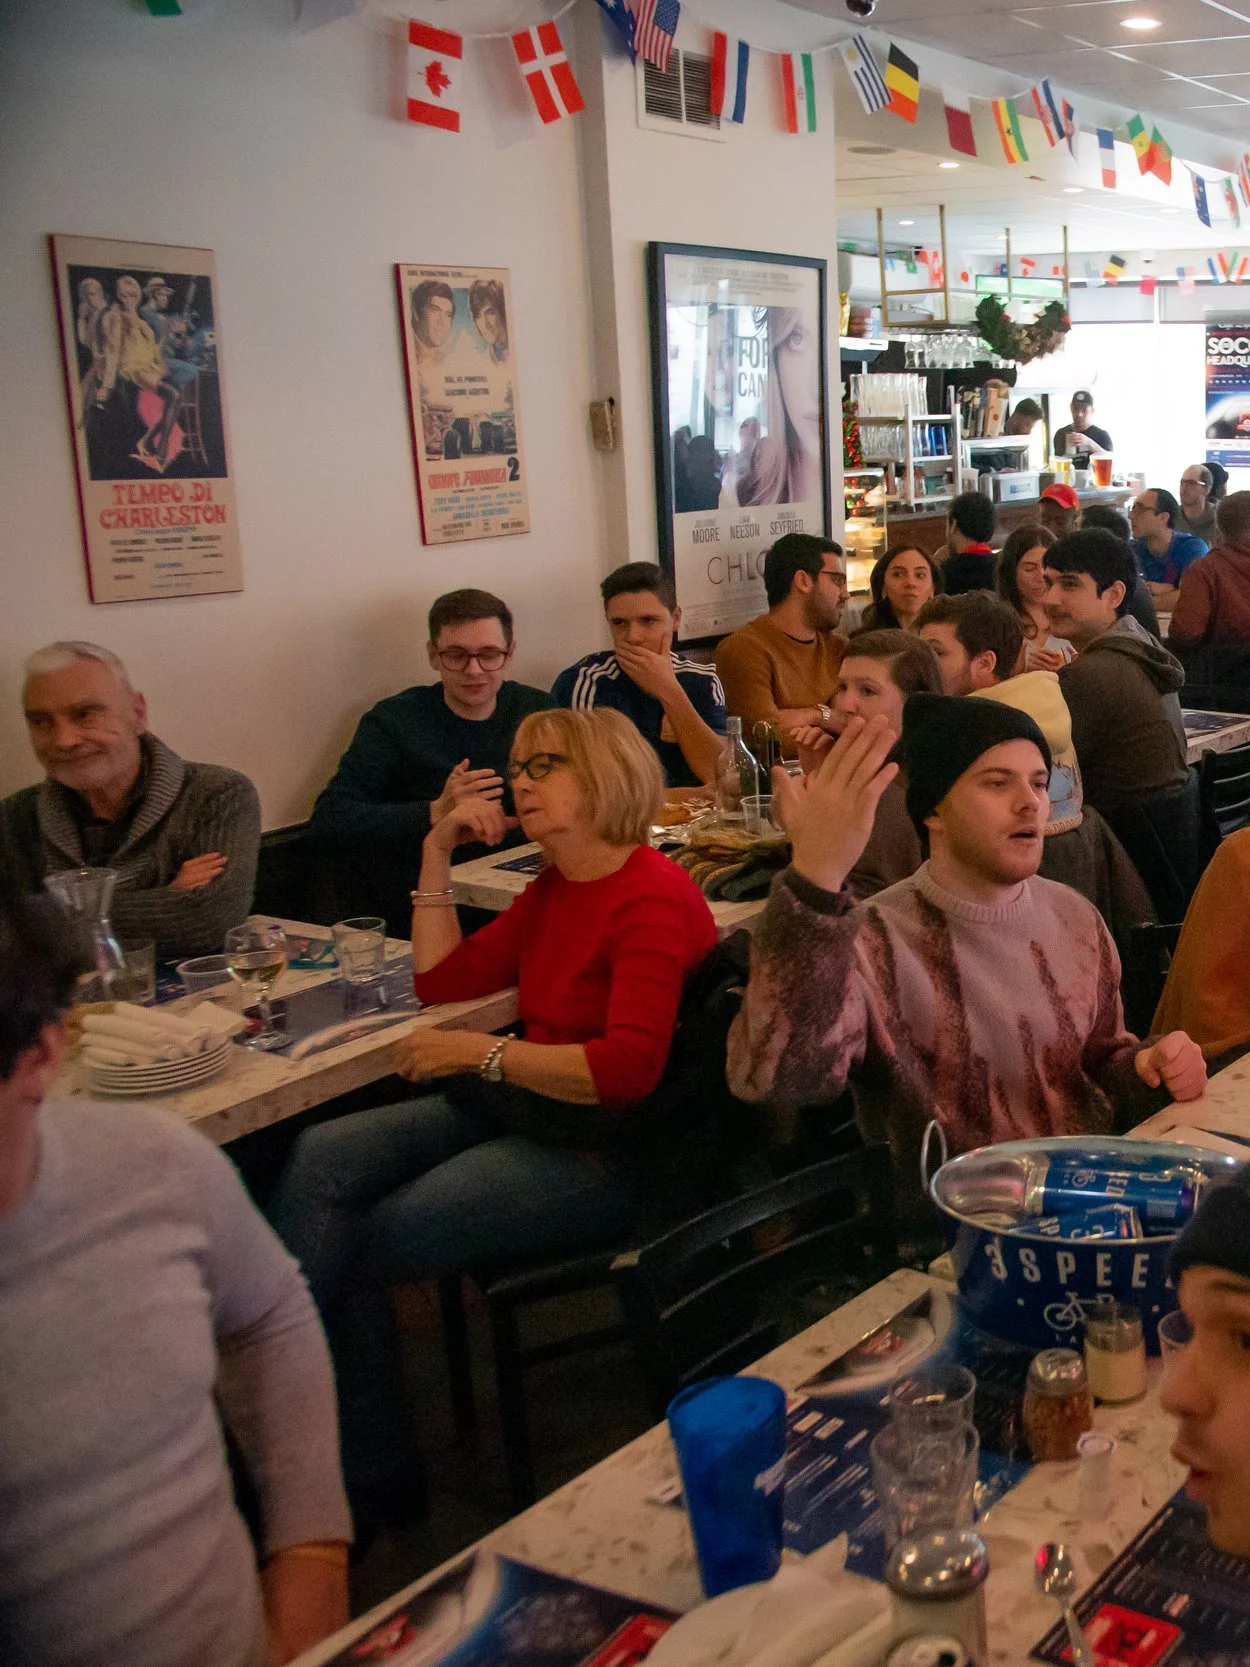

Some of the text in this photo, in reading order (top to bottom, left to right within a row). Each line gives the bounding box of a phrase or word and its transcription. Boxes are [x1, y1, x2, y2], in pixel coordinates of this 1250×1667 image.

[507, 457, 520, 481] 2
[112, 481, 213, 505] TEMPO DI
[100, 504, 227, 529] CHARLESTON
[693, 528, 720, 543] MOORE
[730, 523, 760, 540] NEESON
[770, 519, 804, 536] SEYFRIED
